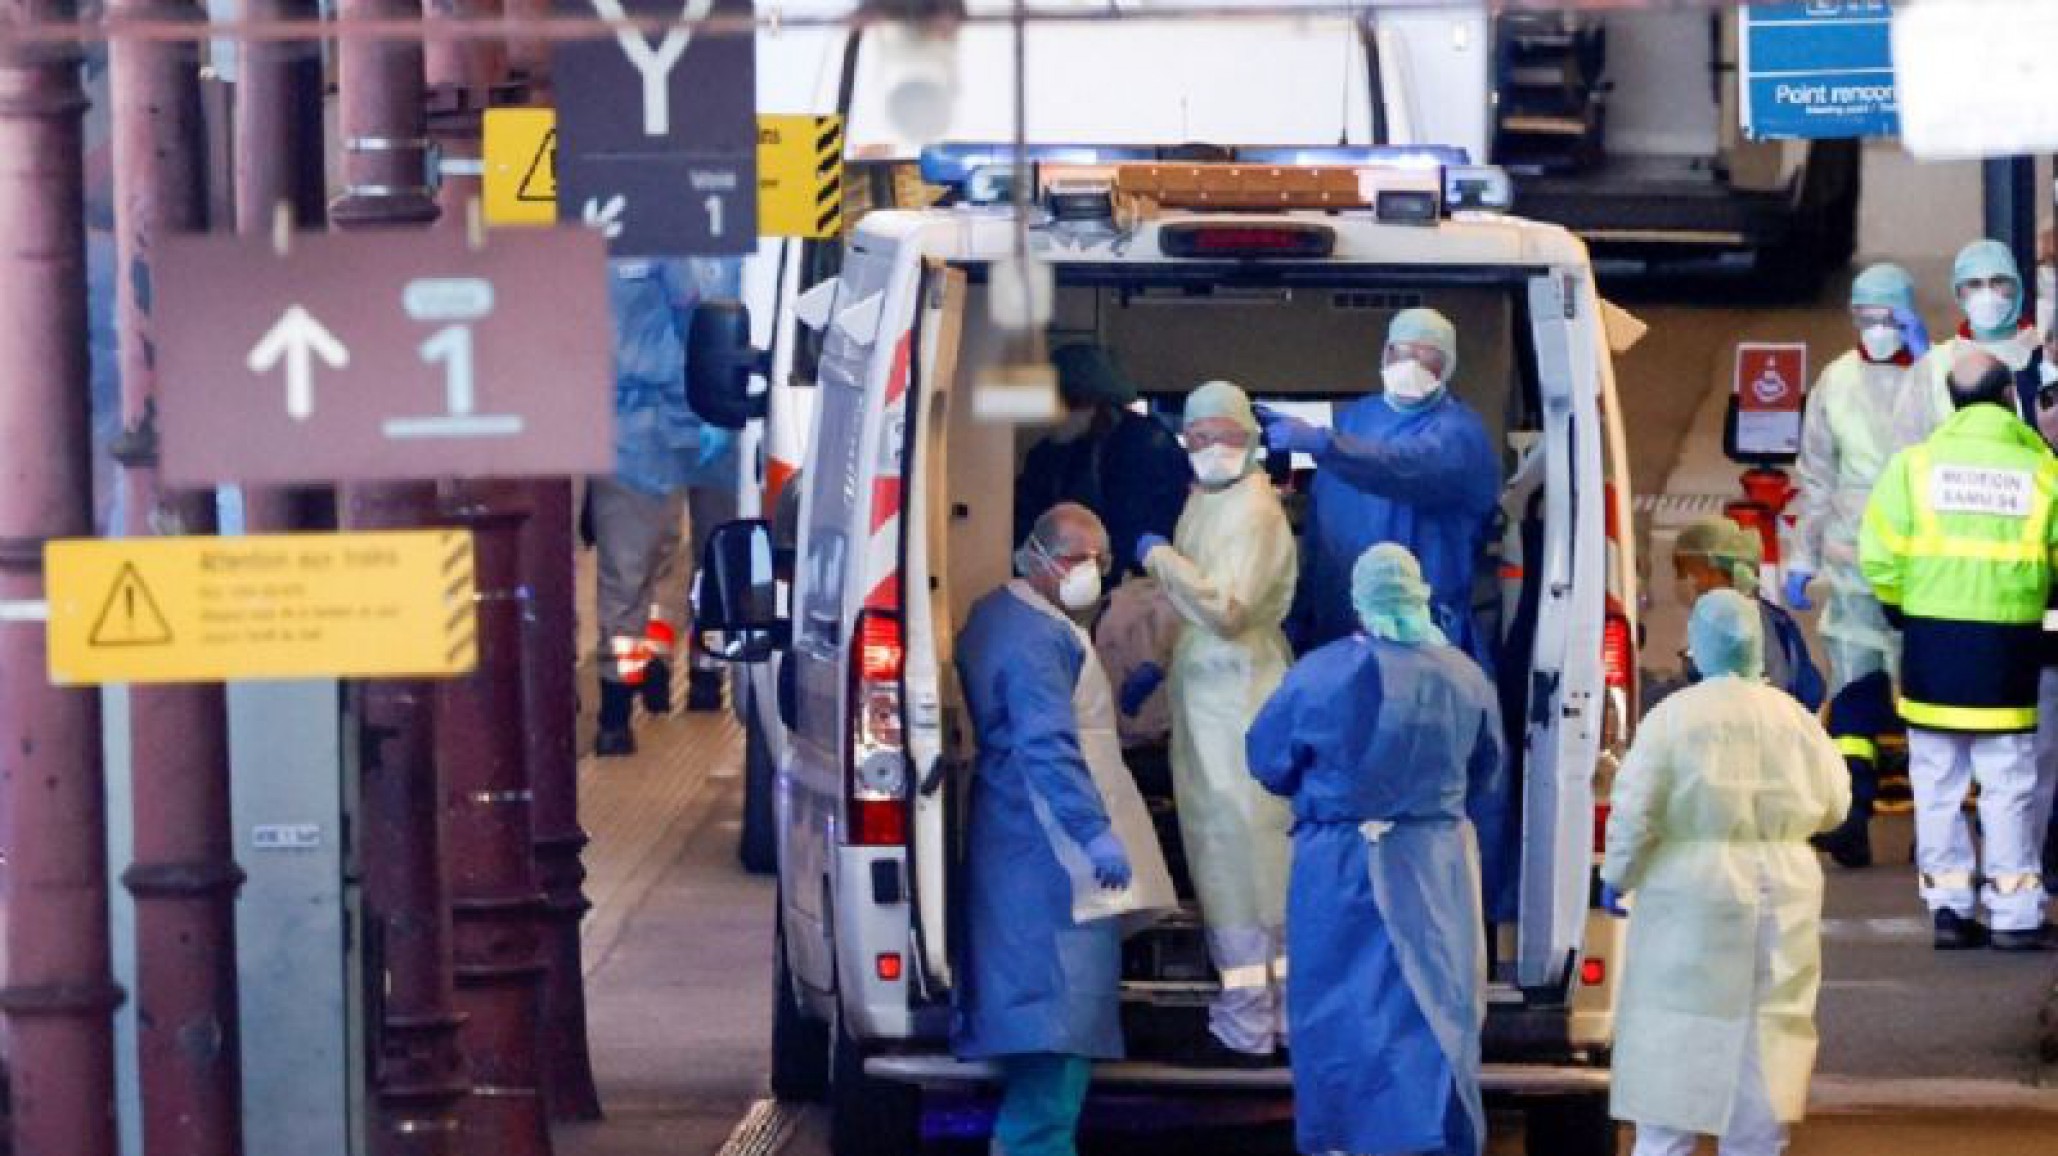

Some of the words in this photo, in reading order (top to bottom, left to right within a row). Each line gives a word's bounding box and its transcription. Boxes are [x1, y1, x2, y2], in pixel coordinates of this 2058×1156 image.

[590, 0, 715, 136] Y
[1776, 83, 1827, 104] Point
[703, 195, 725, 237] 1
[417, 323, 475, 417] 1
